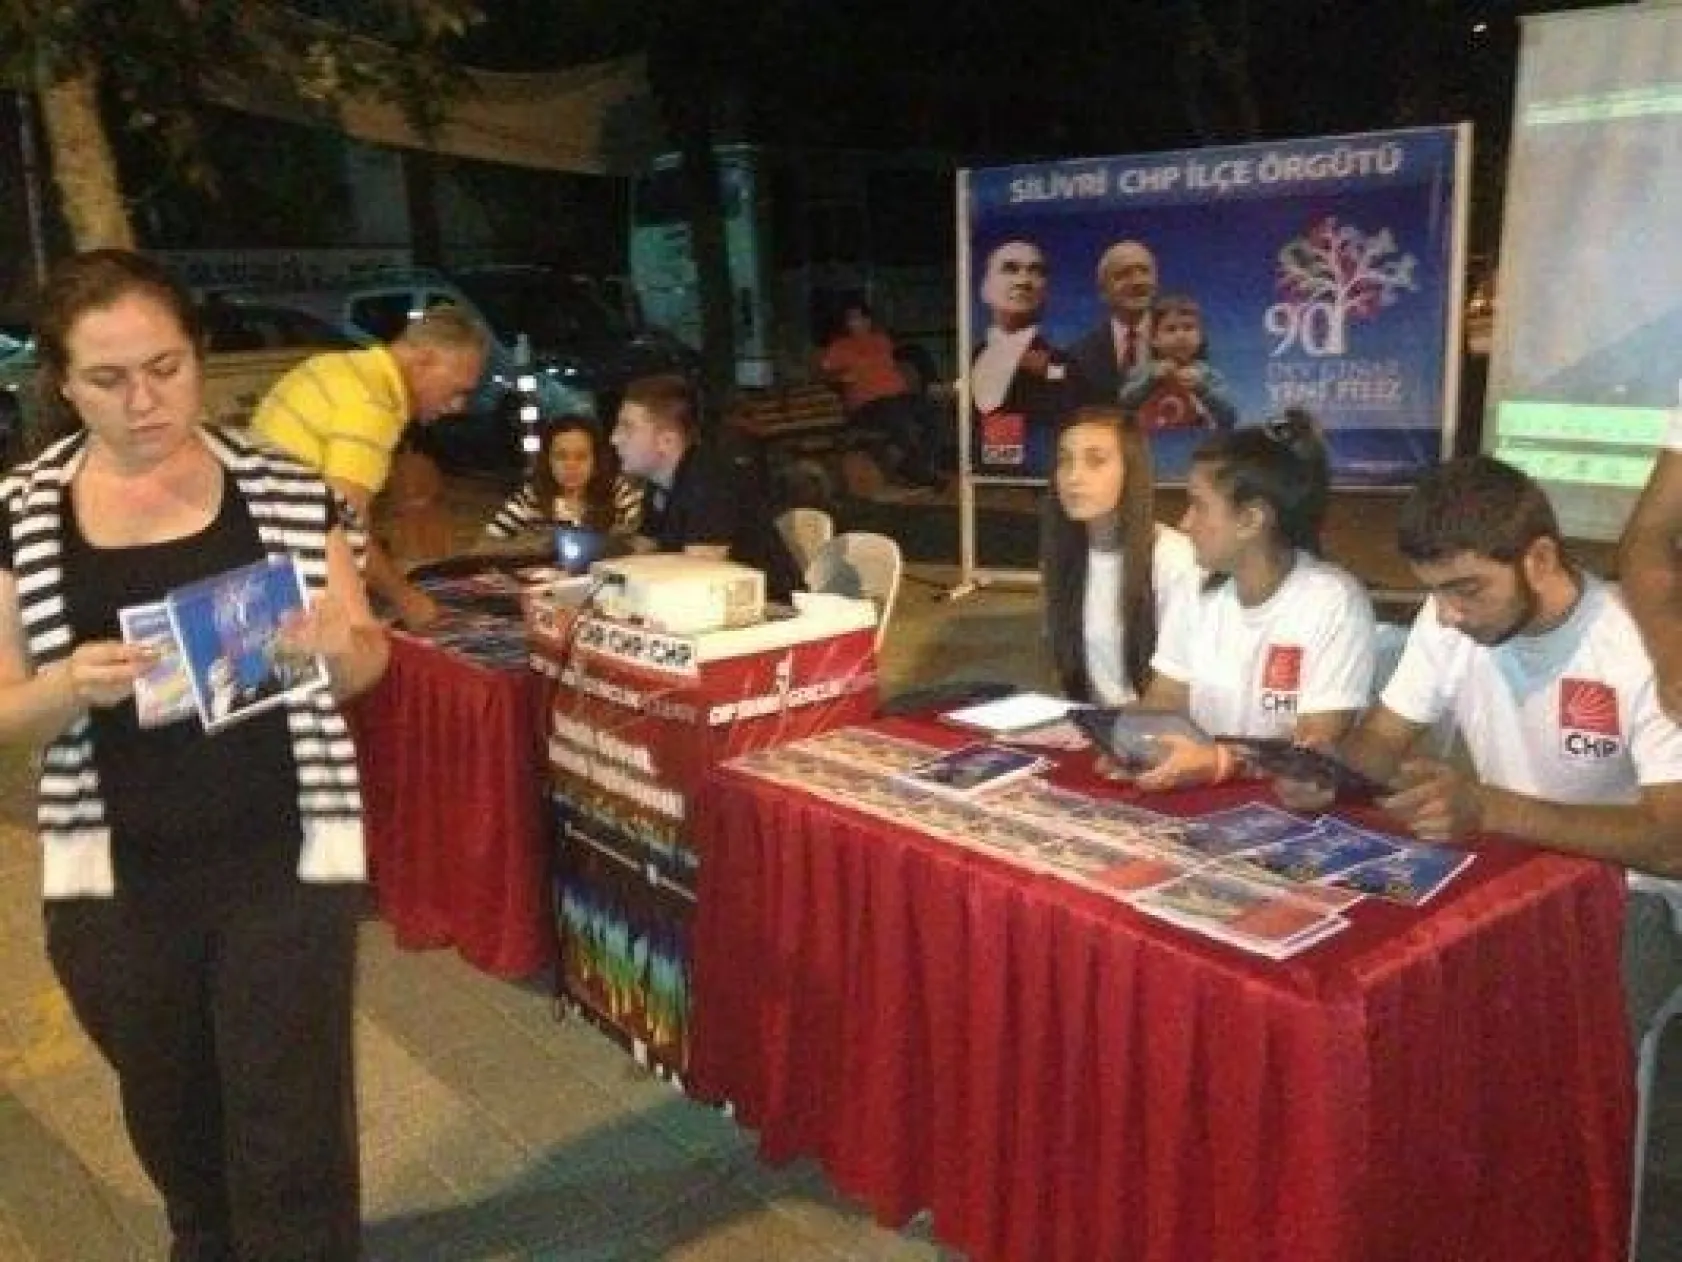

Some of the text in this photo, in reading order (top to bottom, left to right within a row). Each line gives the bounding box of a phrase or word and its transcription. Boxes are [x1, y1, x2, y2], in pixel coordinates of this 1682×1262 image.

[1118, 167, 1180, 193] CHP
[1186, 158, 1251, 193] İLÇE
[1258, 142, 1403, 183] ÖRGÜTÜ
[649, 638, 692, 668] CHP
[1564, 732, 1620, 758] CHP
